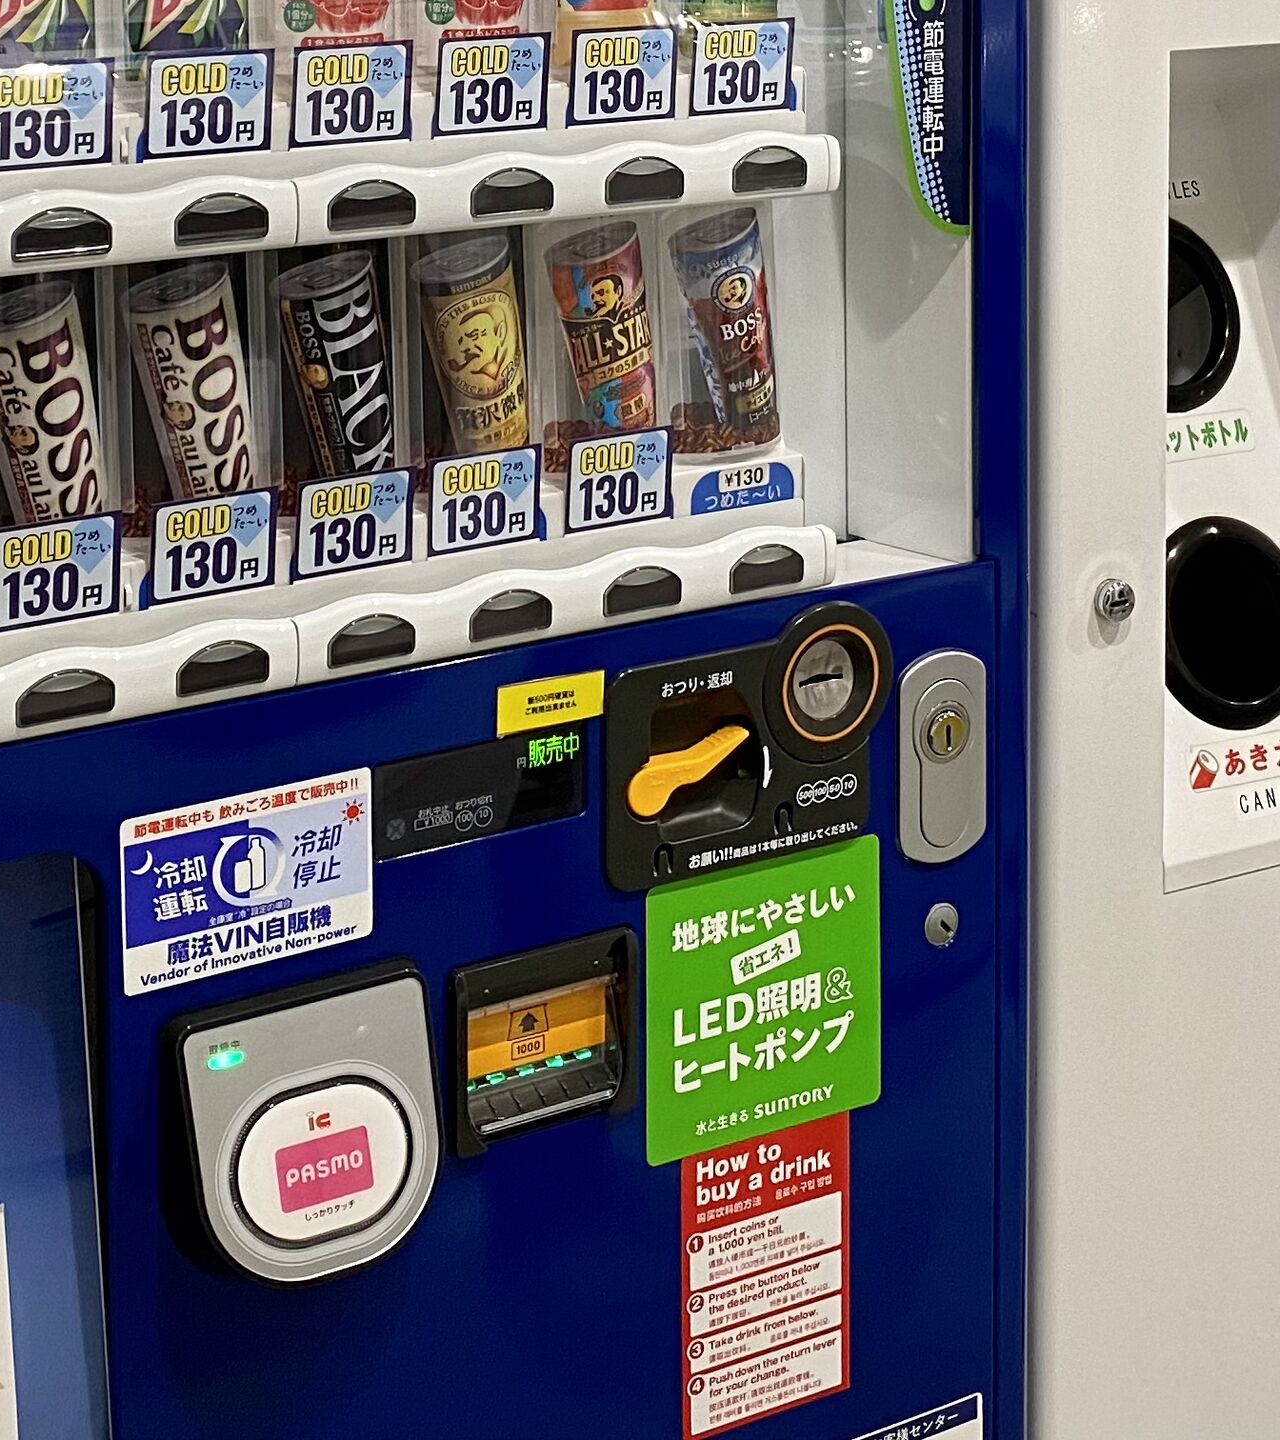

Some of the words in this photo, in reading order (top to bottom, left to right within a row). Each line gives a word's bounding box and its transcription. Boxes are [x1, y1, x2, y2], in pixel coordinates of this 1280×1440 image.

[307, 53, 368, 87] COLD
[584, 69, 663, 114] 130円
[922, 19, 945, 161] 節電運転中
[161, 96, 255, 147] 130円
[720, 307, 763, 341] BOSS
[312, 280, 395, 472] BLACK
[1167, 418, 1248, 453] ットボトル
[580, 440, 634, 475] COLD
[724, 467, 764, 487] ¥130
[579, 472, 658, 523] 130円
[3, 529, 73, 568] COLD
[166, 537, 260, 591] 130円
[661, 671, 733, 697] おつり・返却
[529, 732, 579, 768] 販売中
[134, 809, 214, 838] 節電運転中も
[291, 825, 342, 858] 冷却
[154, 855, 207, 889] 冷却
[293, 856, 341, 889] 停止
[153, 887, 208, 922] 運転
[672, 884, 856, 953] 地球にやさしい
[167, 905, 332, 966] 魔法VIN自販機
[141, 964, 190, 986] Vendor
[194, 960, 208, 973] of
[211, 939, 282, 969] Innovative
[286, 925, 357, 950] Non-power
[739, 938, 793, 977] 省エネ!
[674, 1010, 854, 1093] ヒートポンプ
[696, 1109, 748, 1135] 水と生きる
[285, 1150, 364, 1189] PASMO
[696, 1150, 749, 1182] How
[758, 1143, 781, 1164] to
[696, 1178, 740, 1206] buy
[749, 1174, 763, 1189] a
[770, 1149, 831, 1184] drink
[305, 1200, 355, 1222] しっかりタッチ
[709, 1227, 737, 1244] Insert
[739, 1220, 766, 1236] coins
[769, 1216, 779, 1225] or
[709, 1285, 737, 1303] Press
[758, 1272, 789, 1288] button
[792, 1262, 821, 1276] below
[727, 1292, 763, 1310] desired
[709, 1337, 733, 1350] Take
[736, 1327, 761, 1341] drink
[764, 1320, 786, 1333] from
[709, 1372, 733, 1386] Push
[735, 1364, 760, 1377] down
[781, 1347, 810, 1363] return
[813, 1338, 836, 1351] lever
